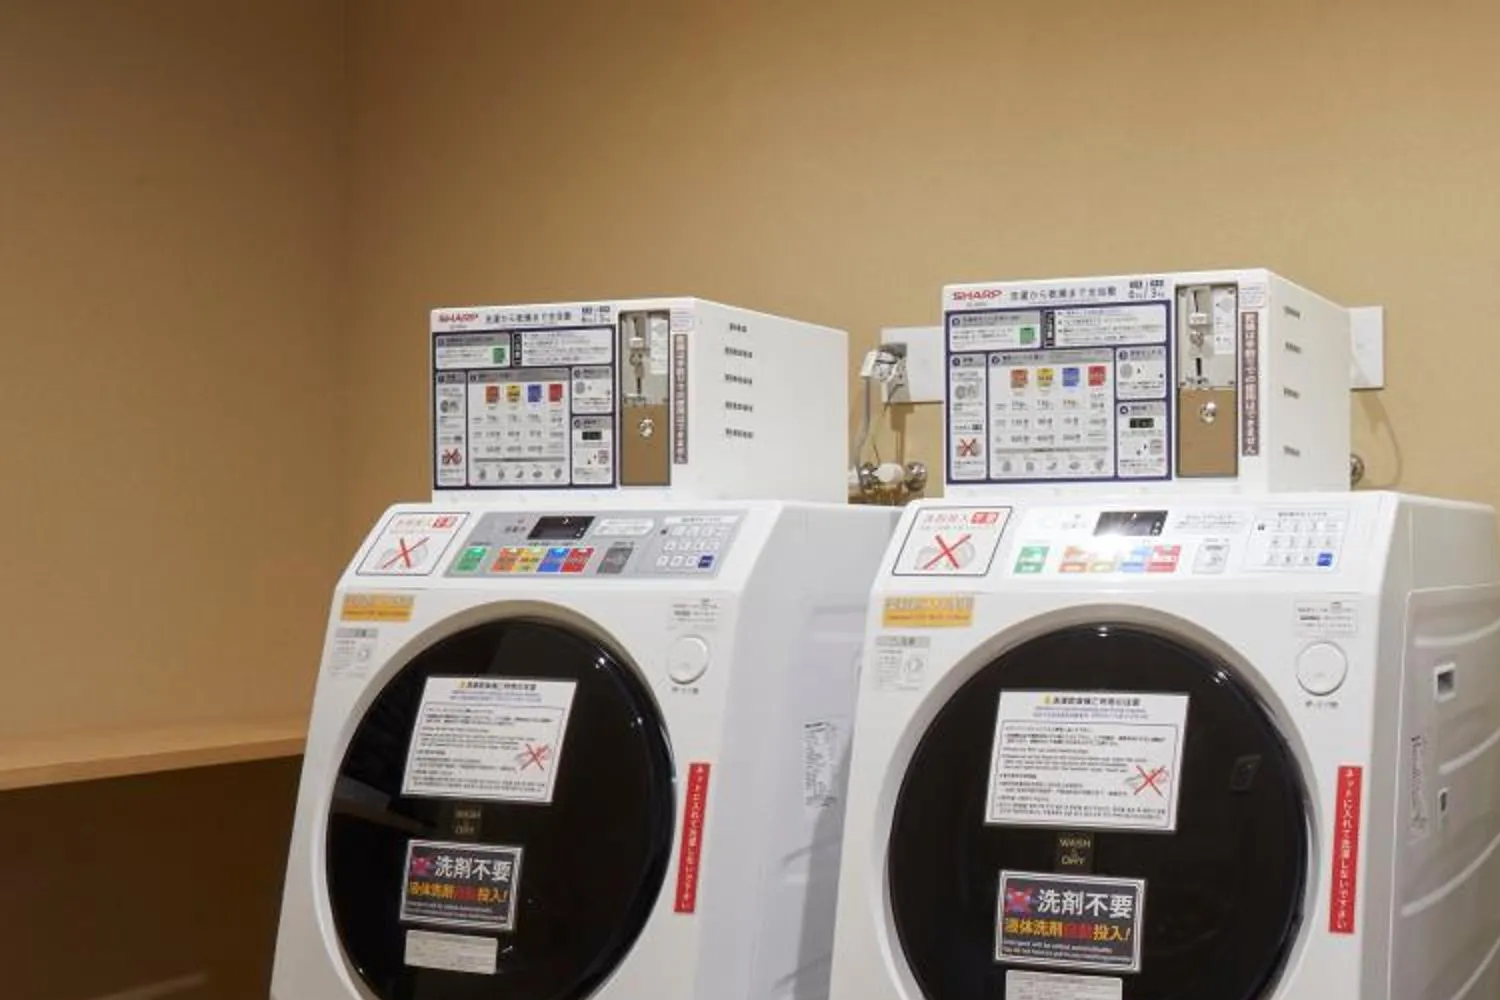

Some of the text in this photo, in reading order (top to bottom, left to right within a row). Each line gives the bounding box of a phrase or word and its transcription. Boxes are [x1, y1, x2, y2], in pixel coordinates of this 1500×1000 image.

[953, 290, 1002, 300] SHARP
[435, 855, 513, 883] 洗剤不要
[1037, 889, 1134, 919] 洗剤不要
